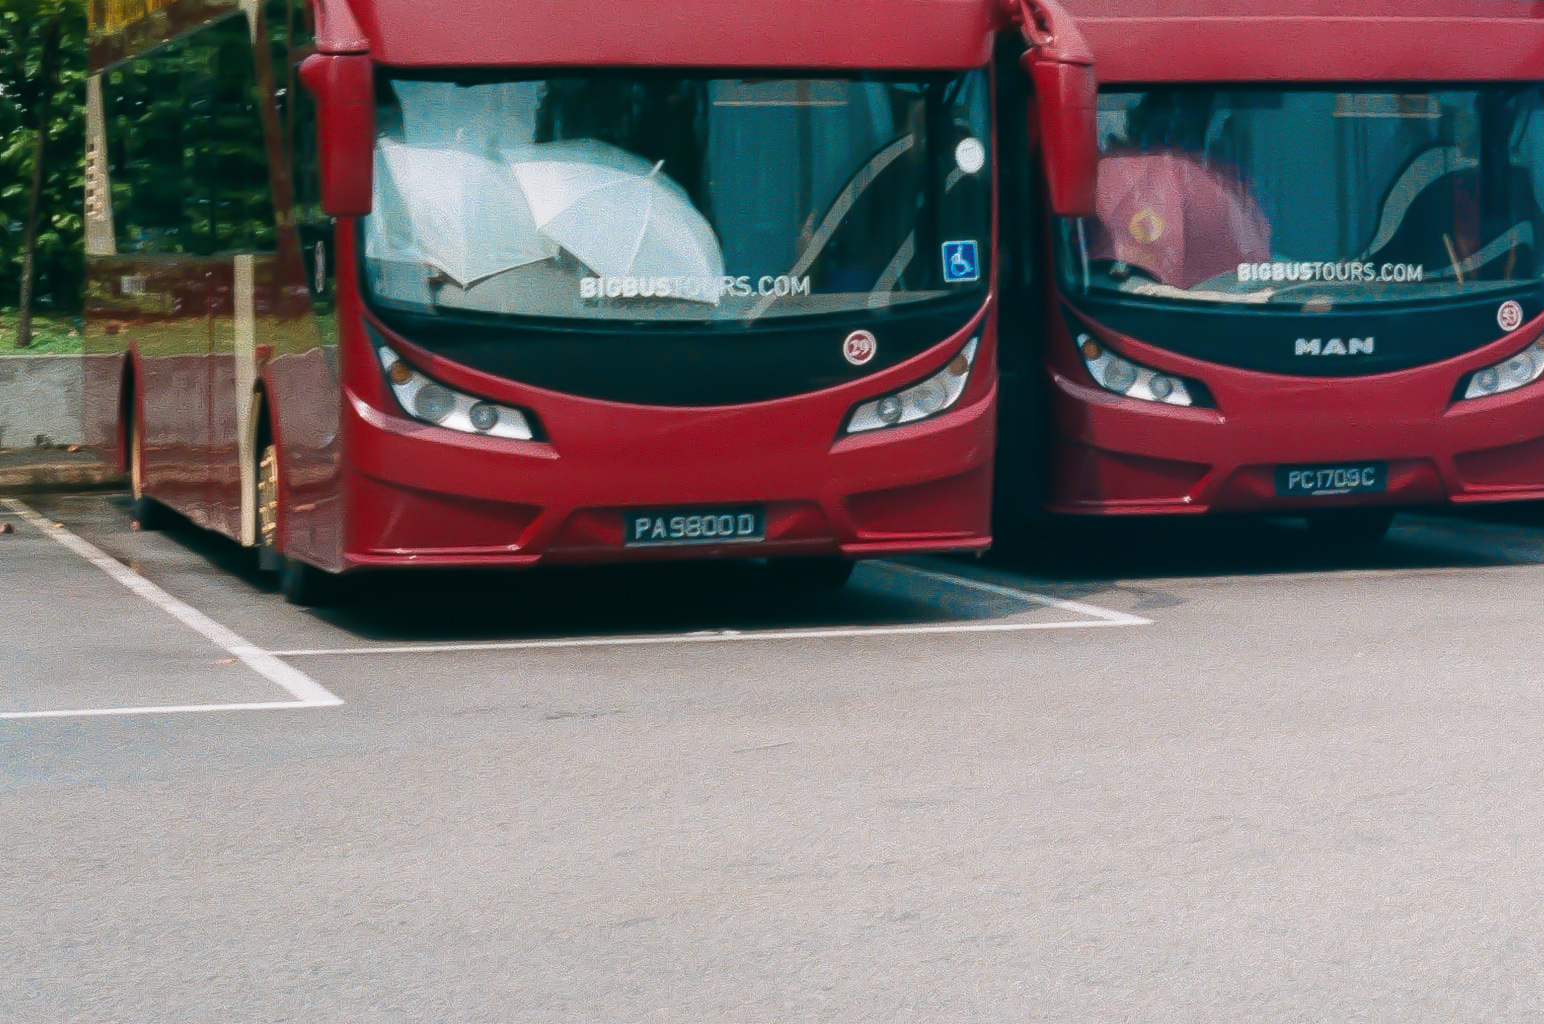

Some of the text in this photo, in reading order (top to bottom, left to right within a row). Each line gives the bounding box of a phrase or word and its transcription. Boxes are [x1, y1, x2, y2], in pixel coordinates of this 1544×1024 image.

[1237, 262, 1424, 282] BIGBUSTOURS.COM
[1295, 337, 1375, 356] MAN
[1288, 467, 1376, 489] PC1709C
[635, 513, 755, 539] PA9800D
